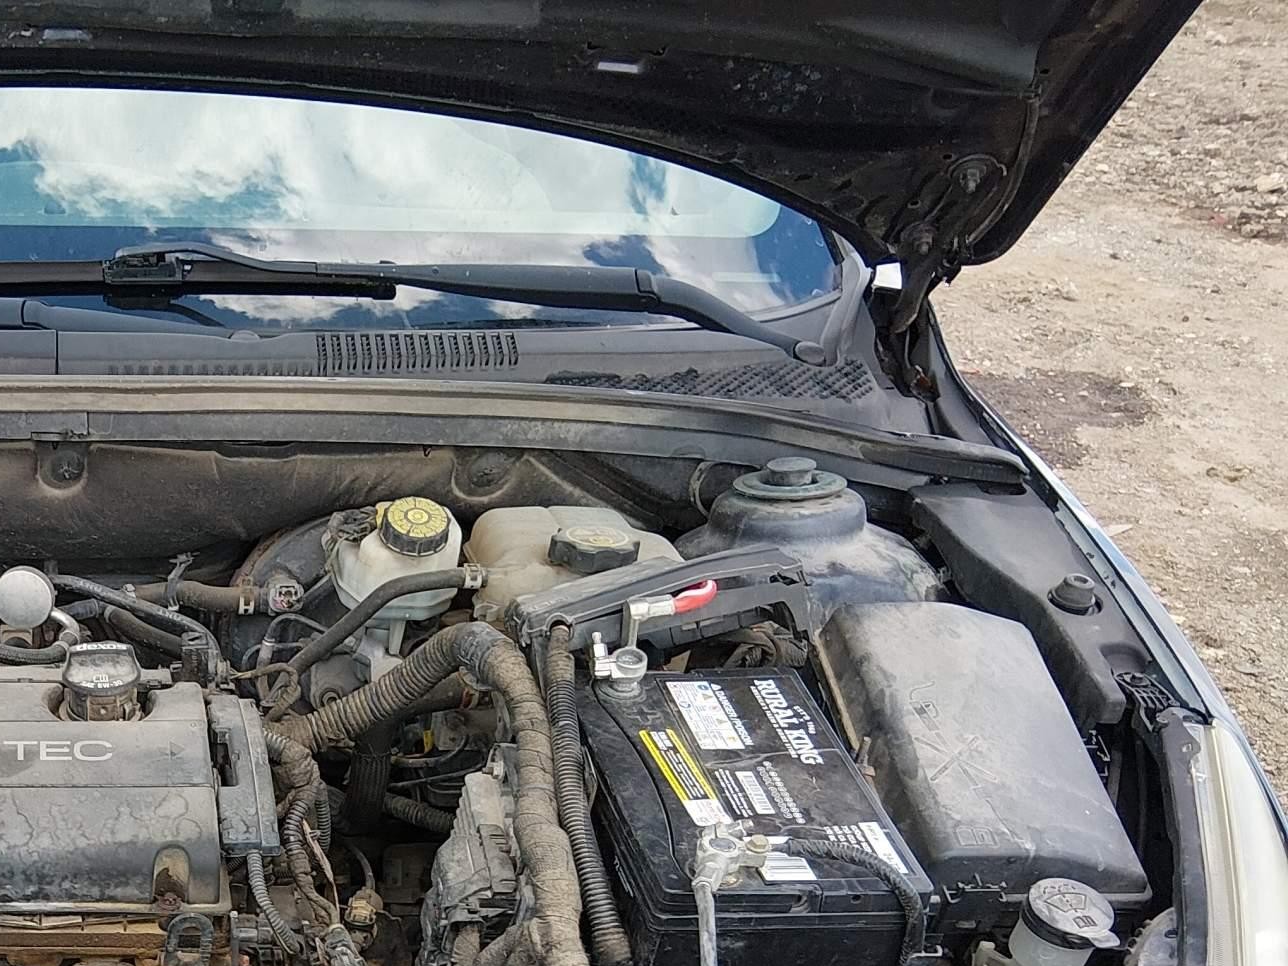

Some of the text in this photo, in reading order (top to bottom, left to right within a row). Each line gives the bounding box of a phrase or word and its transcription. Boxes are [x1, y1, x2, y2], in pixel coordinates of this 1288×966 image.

[76, 643, 128, 651] dexos
[753, 679, 800, 728] RURAL
[783, 728, 825, 765] KING
